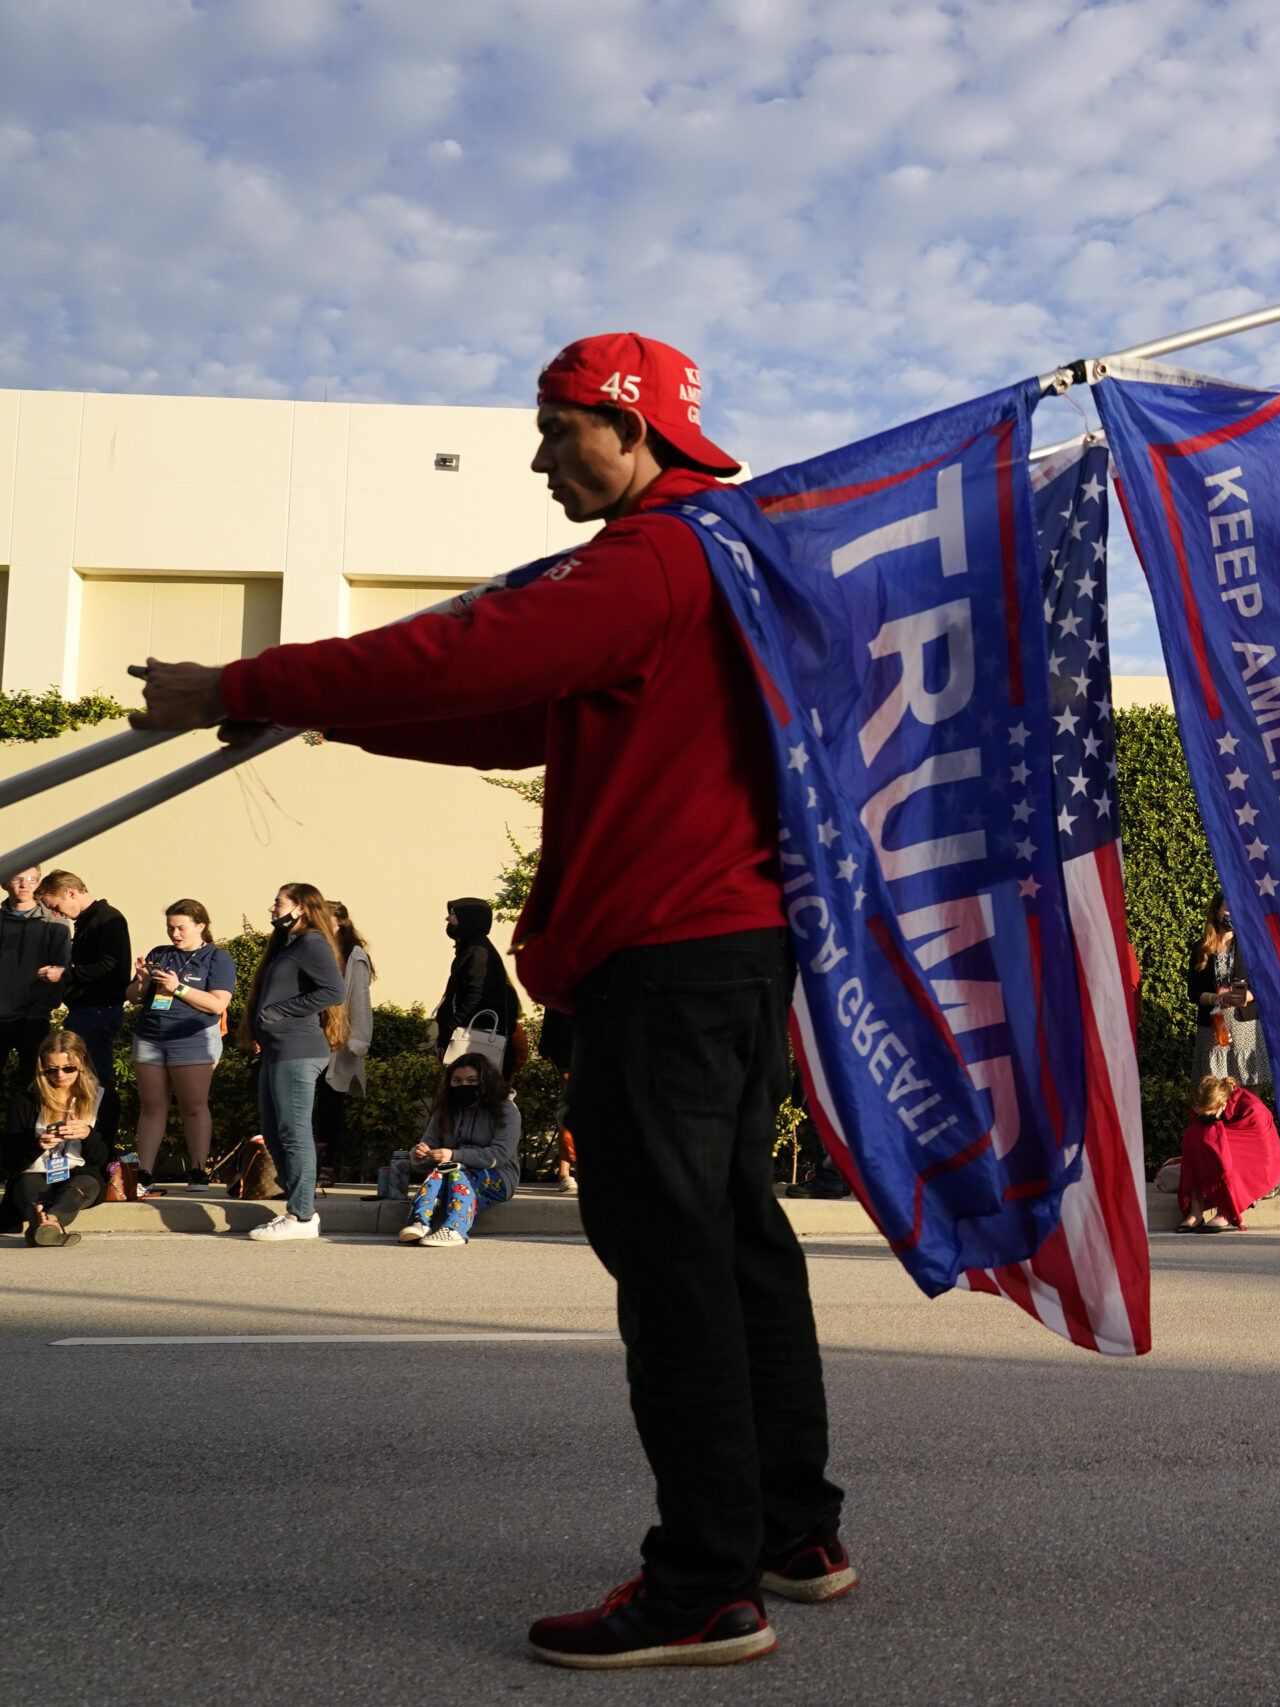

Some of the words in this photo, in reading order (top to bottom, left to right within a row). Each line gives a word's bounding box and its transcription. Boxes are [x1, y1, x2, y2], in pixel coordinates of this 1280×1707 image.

[600, 371, 642, 403] 45
[1204, 466, 1263, 617] KEEP
[831, 463, 1021, 1160] TRUMP
